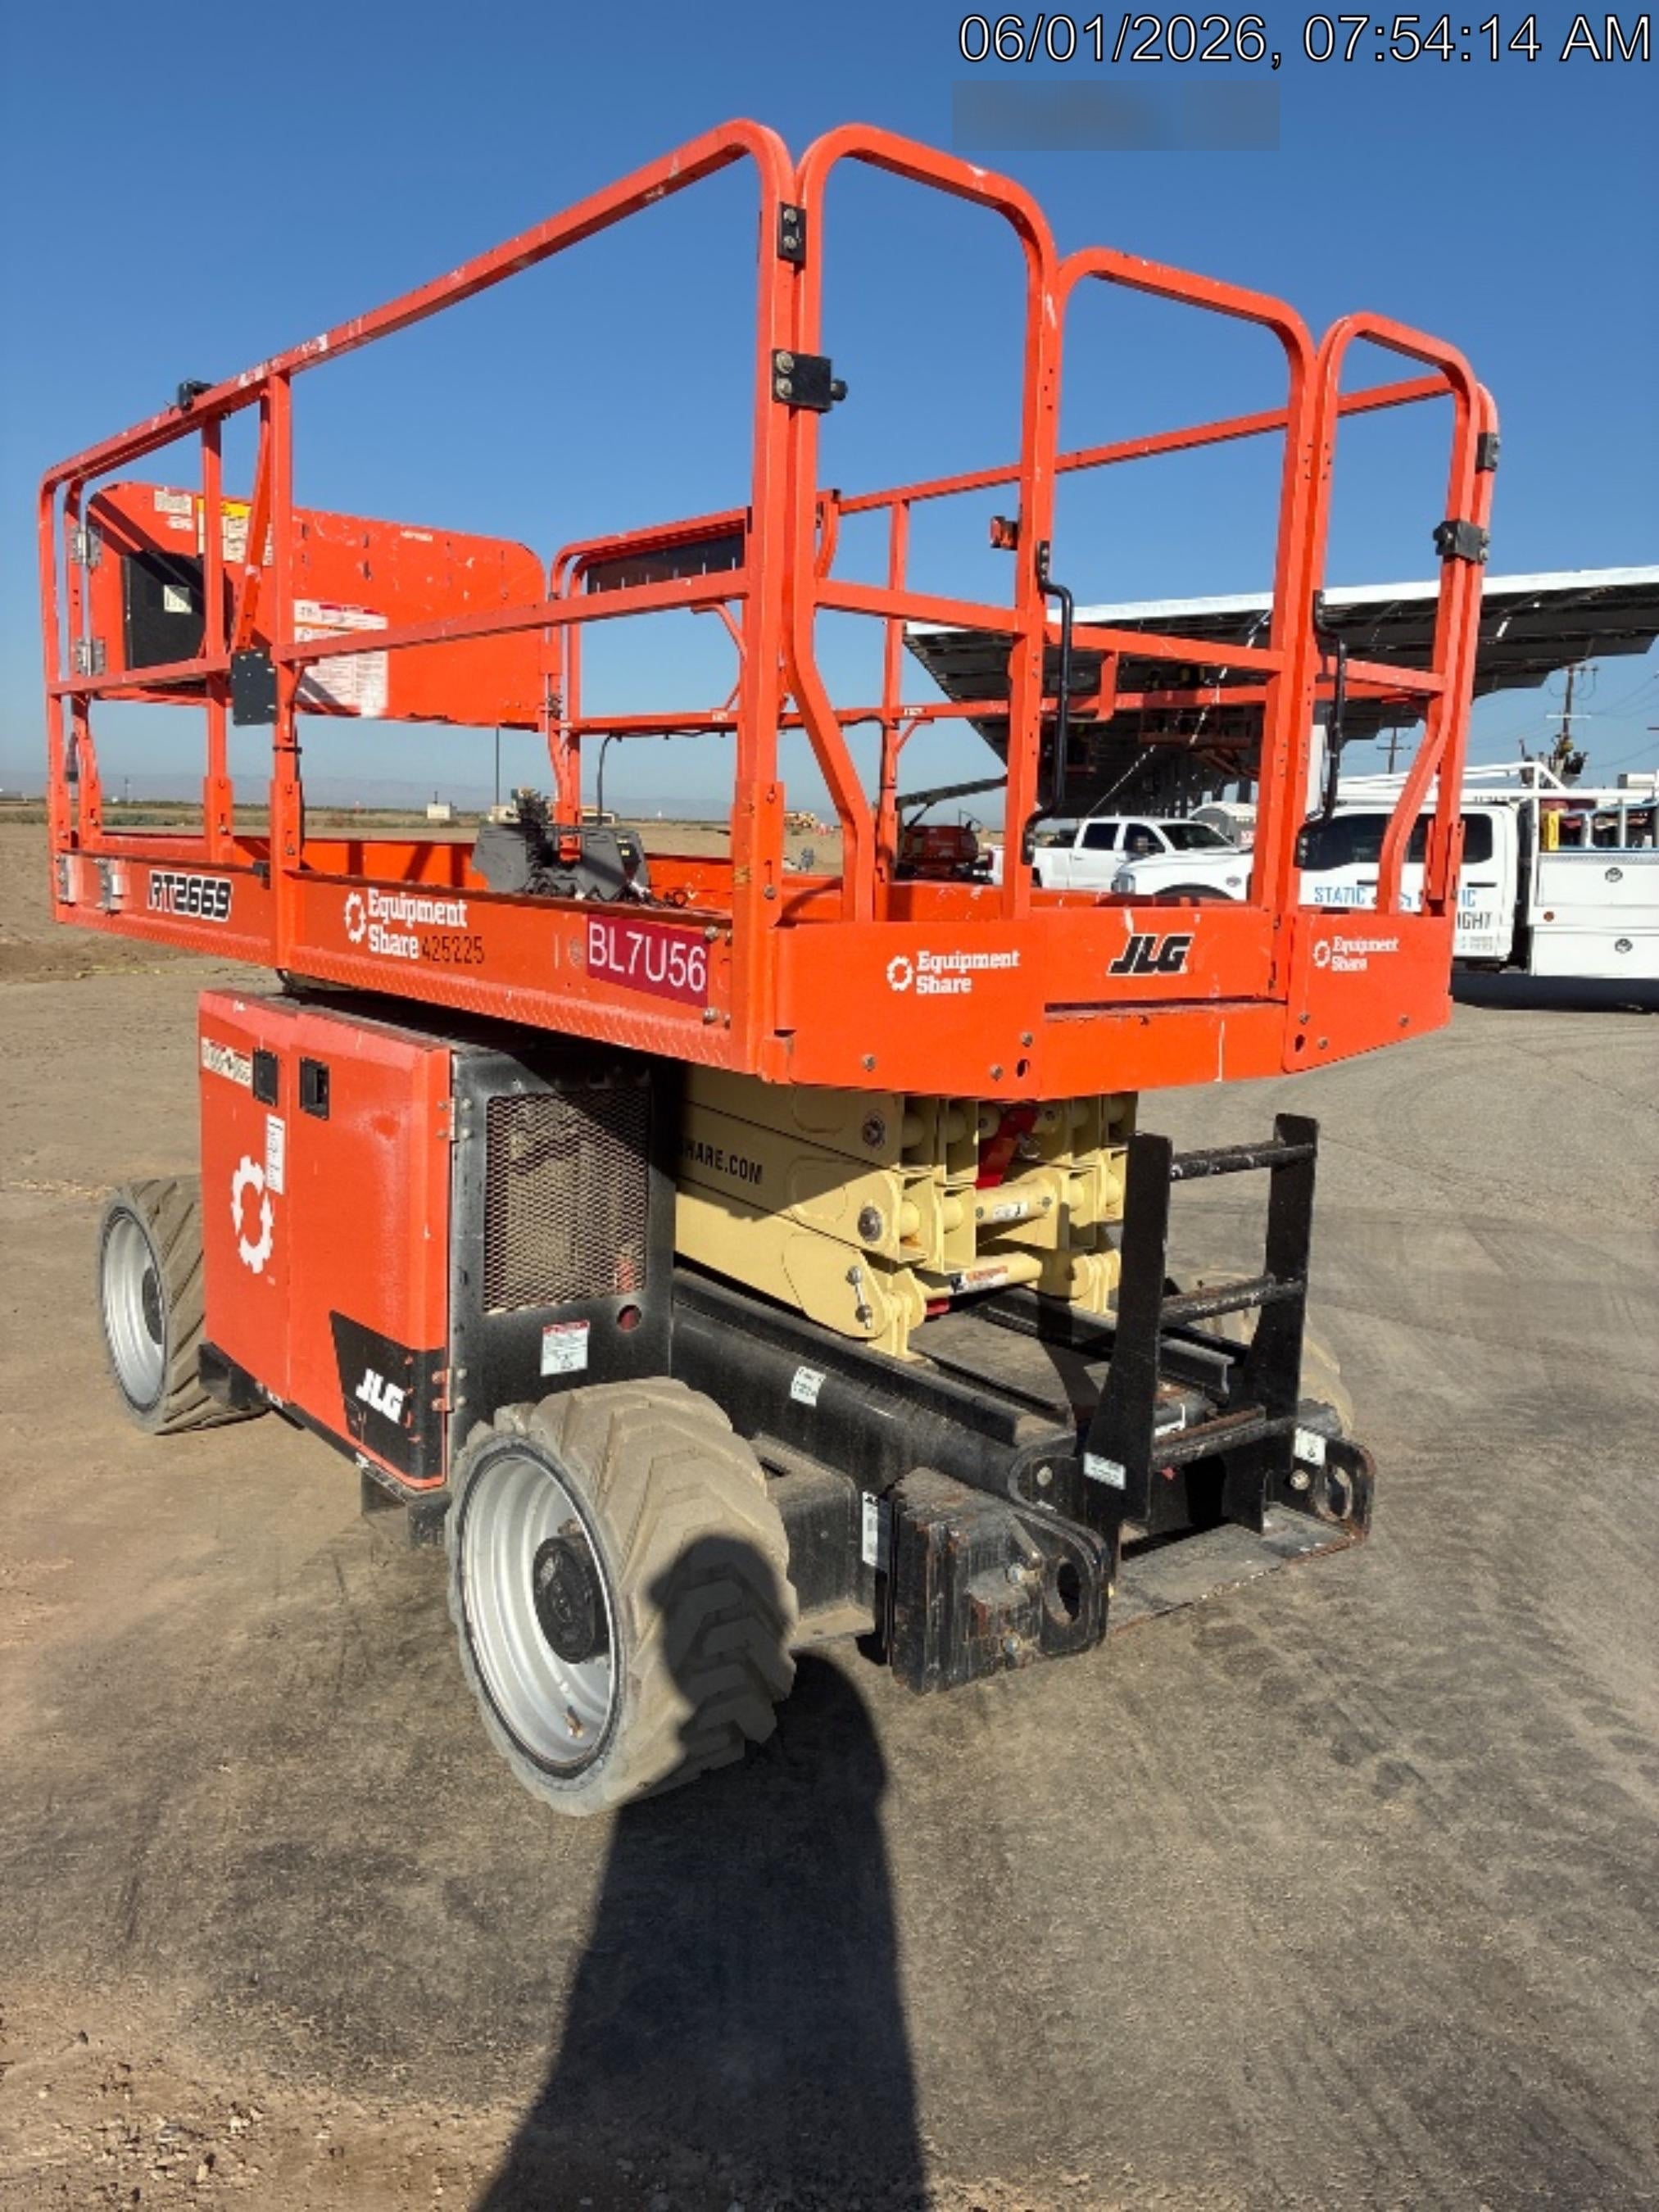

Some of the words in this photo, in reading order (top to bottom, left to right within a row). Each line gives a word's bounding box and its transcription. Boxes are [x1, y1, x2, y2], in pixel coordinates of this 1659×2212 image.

[367, 887, 468, 929] Equipment
[1314, 886, 1367, 904] STATIC
[368, 922, 419, 959] Share
[422, 936, 485, 964] 425225
[588, 921, 707, 993] BL7U56
[1106, 933, 1195, 976] JLG
[1332, 936, 1399, 956] Equipment
[916, 950, 1021, 974] Equipment
[1331, 955, 1367, 972] Share
[916, 975, 972, 995] Share
[356, 1367, 406, 1424] JLG
